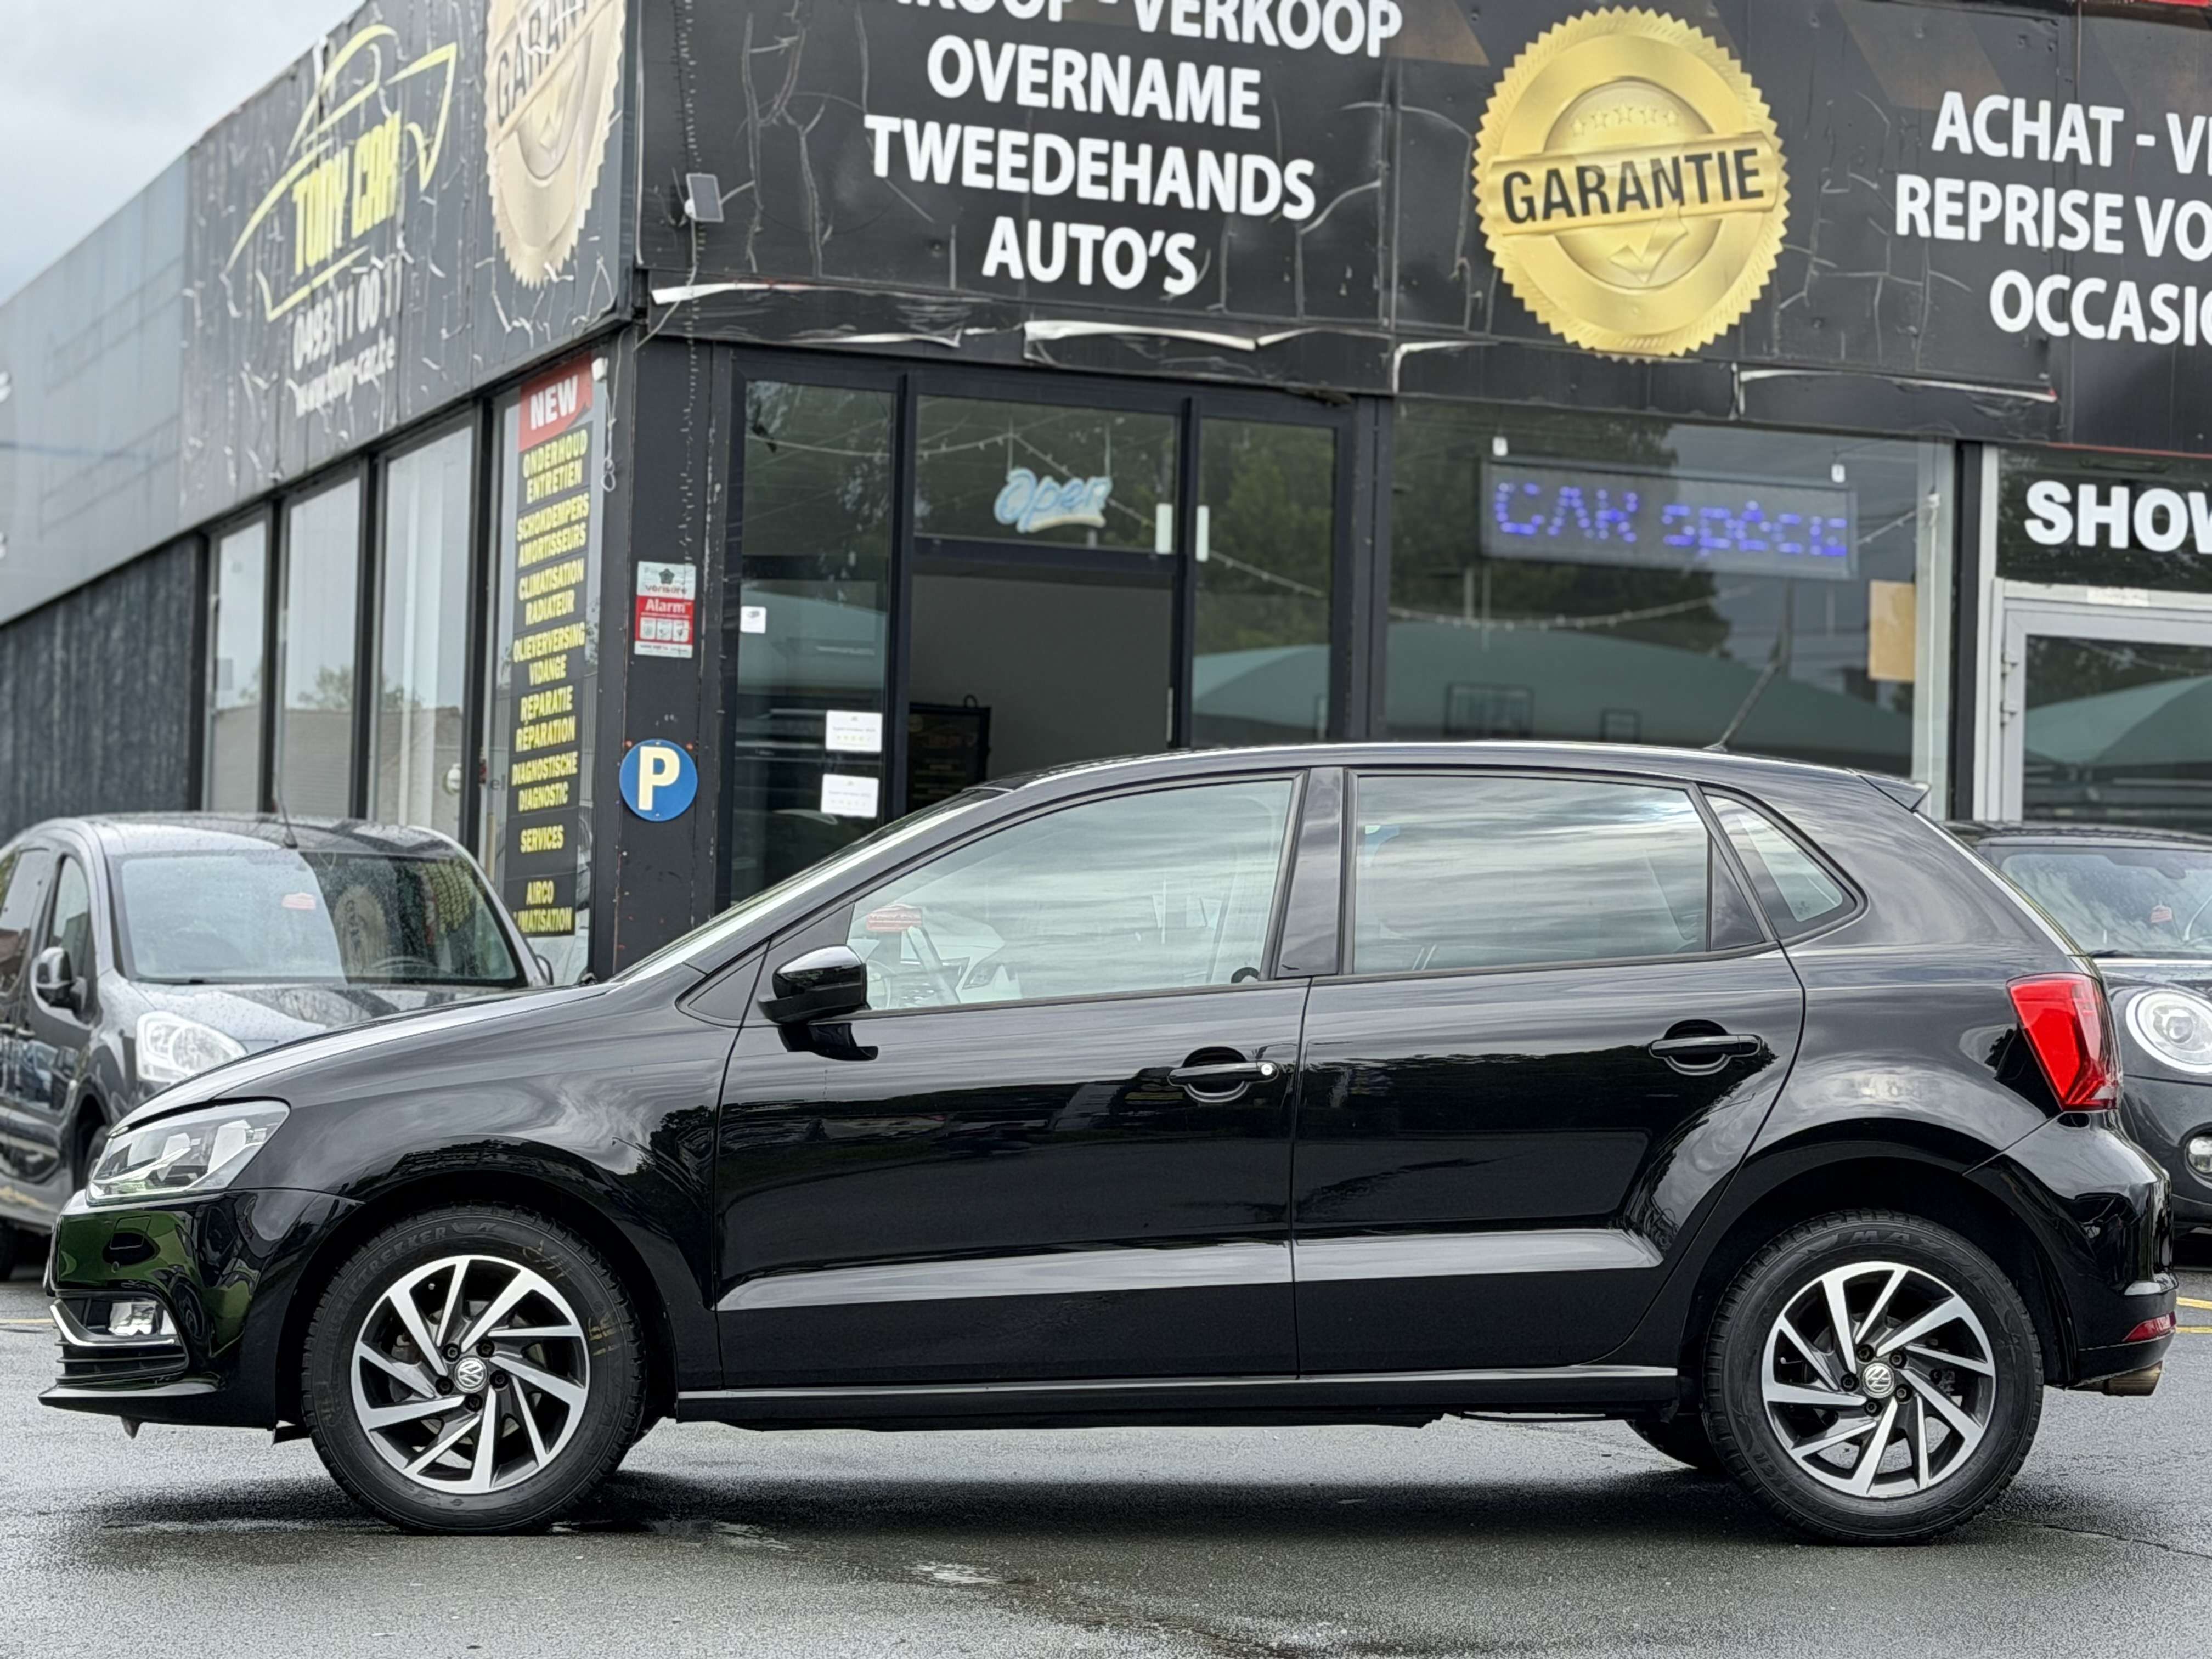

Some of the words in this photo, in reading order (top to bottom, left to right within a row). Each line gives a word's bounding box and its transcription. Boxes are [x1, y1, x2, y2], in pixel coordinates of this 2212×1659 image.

[1135, 0, 1402, 57] VERKOOP
[497, 0, 586, 128] GARAN
[928, 35, 1260, 129] OVERNAME
[1932, 91, 2124, 167] ACHAT
[2166, 113, 2212, 176] V
[352, 110, 401, 238] CAR
[865, 115, 1314, 219] TWEEDEHANDS
[1501, 147, 1766, 224] GARANTIE
[1897, 174, 2123, 253] REPRISE
[2135, 196, 2212, 261] VO
[336, 283, 354, 346] 11
[358, 267, 380, 334] 00
[1990, 270, 2212, 346] OCCASI
[531, 375, 578, 431] NEW
[523, 429, 588, 478] ONDERHOUD
[527, 459, 582, 504] ENTRETIEN
[994, 468, 1113, 533] Open
[517, 492, 589, 541] SCHOKDEMPERS
[518, 522, 586, 568] AMORTISSEURS
[519, 558, 584, 601] CLIMATISATION
[526, 589, 574, 625] RADIATEUR
[645, 598, 685, 613] Alarm
[514, 622, 585, 663] OLIEVERVERSING
[529, 654, 567, 686] VIDANGE
[520, 685, 573, 721] REPARATIE
[511, 751, 578, 786] DIAGNOSTISCHE
[638, 746, 680, 810] P
[518, 781, 568, 812] DIAGNOSTIC
[520, 825, 564, 853] SERVICES
[526, 880, 554, 905] AIRCO
[514, 907, 572, 933] IMATISATION
